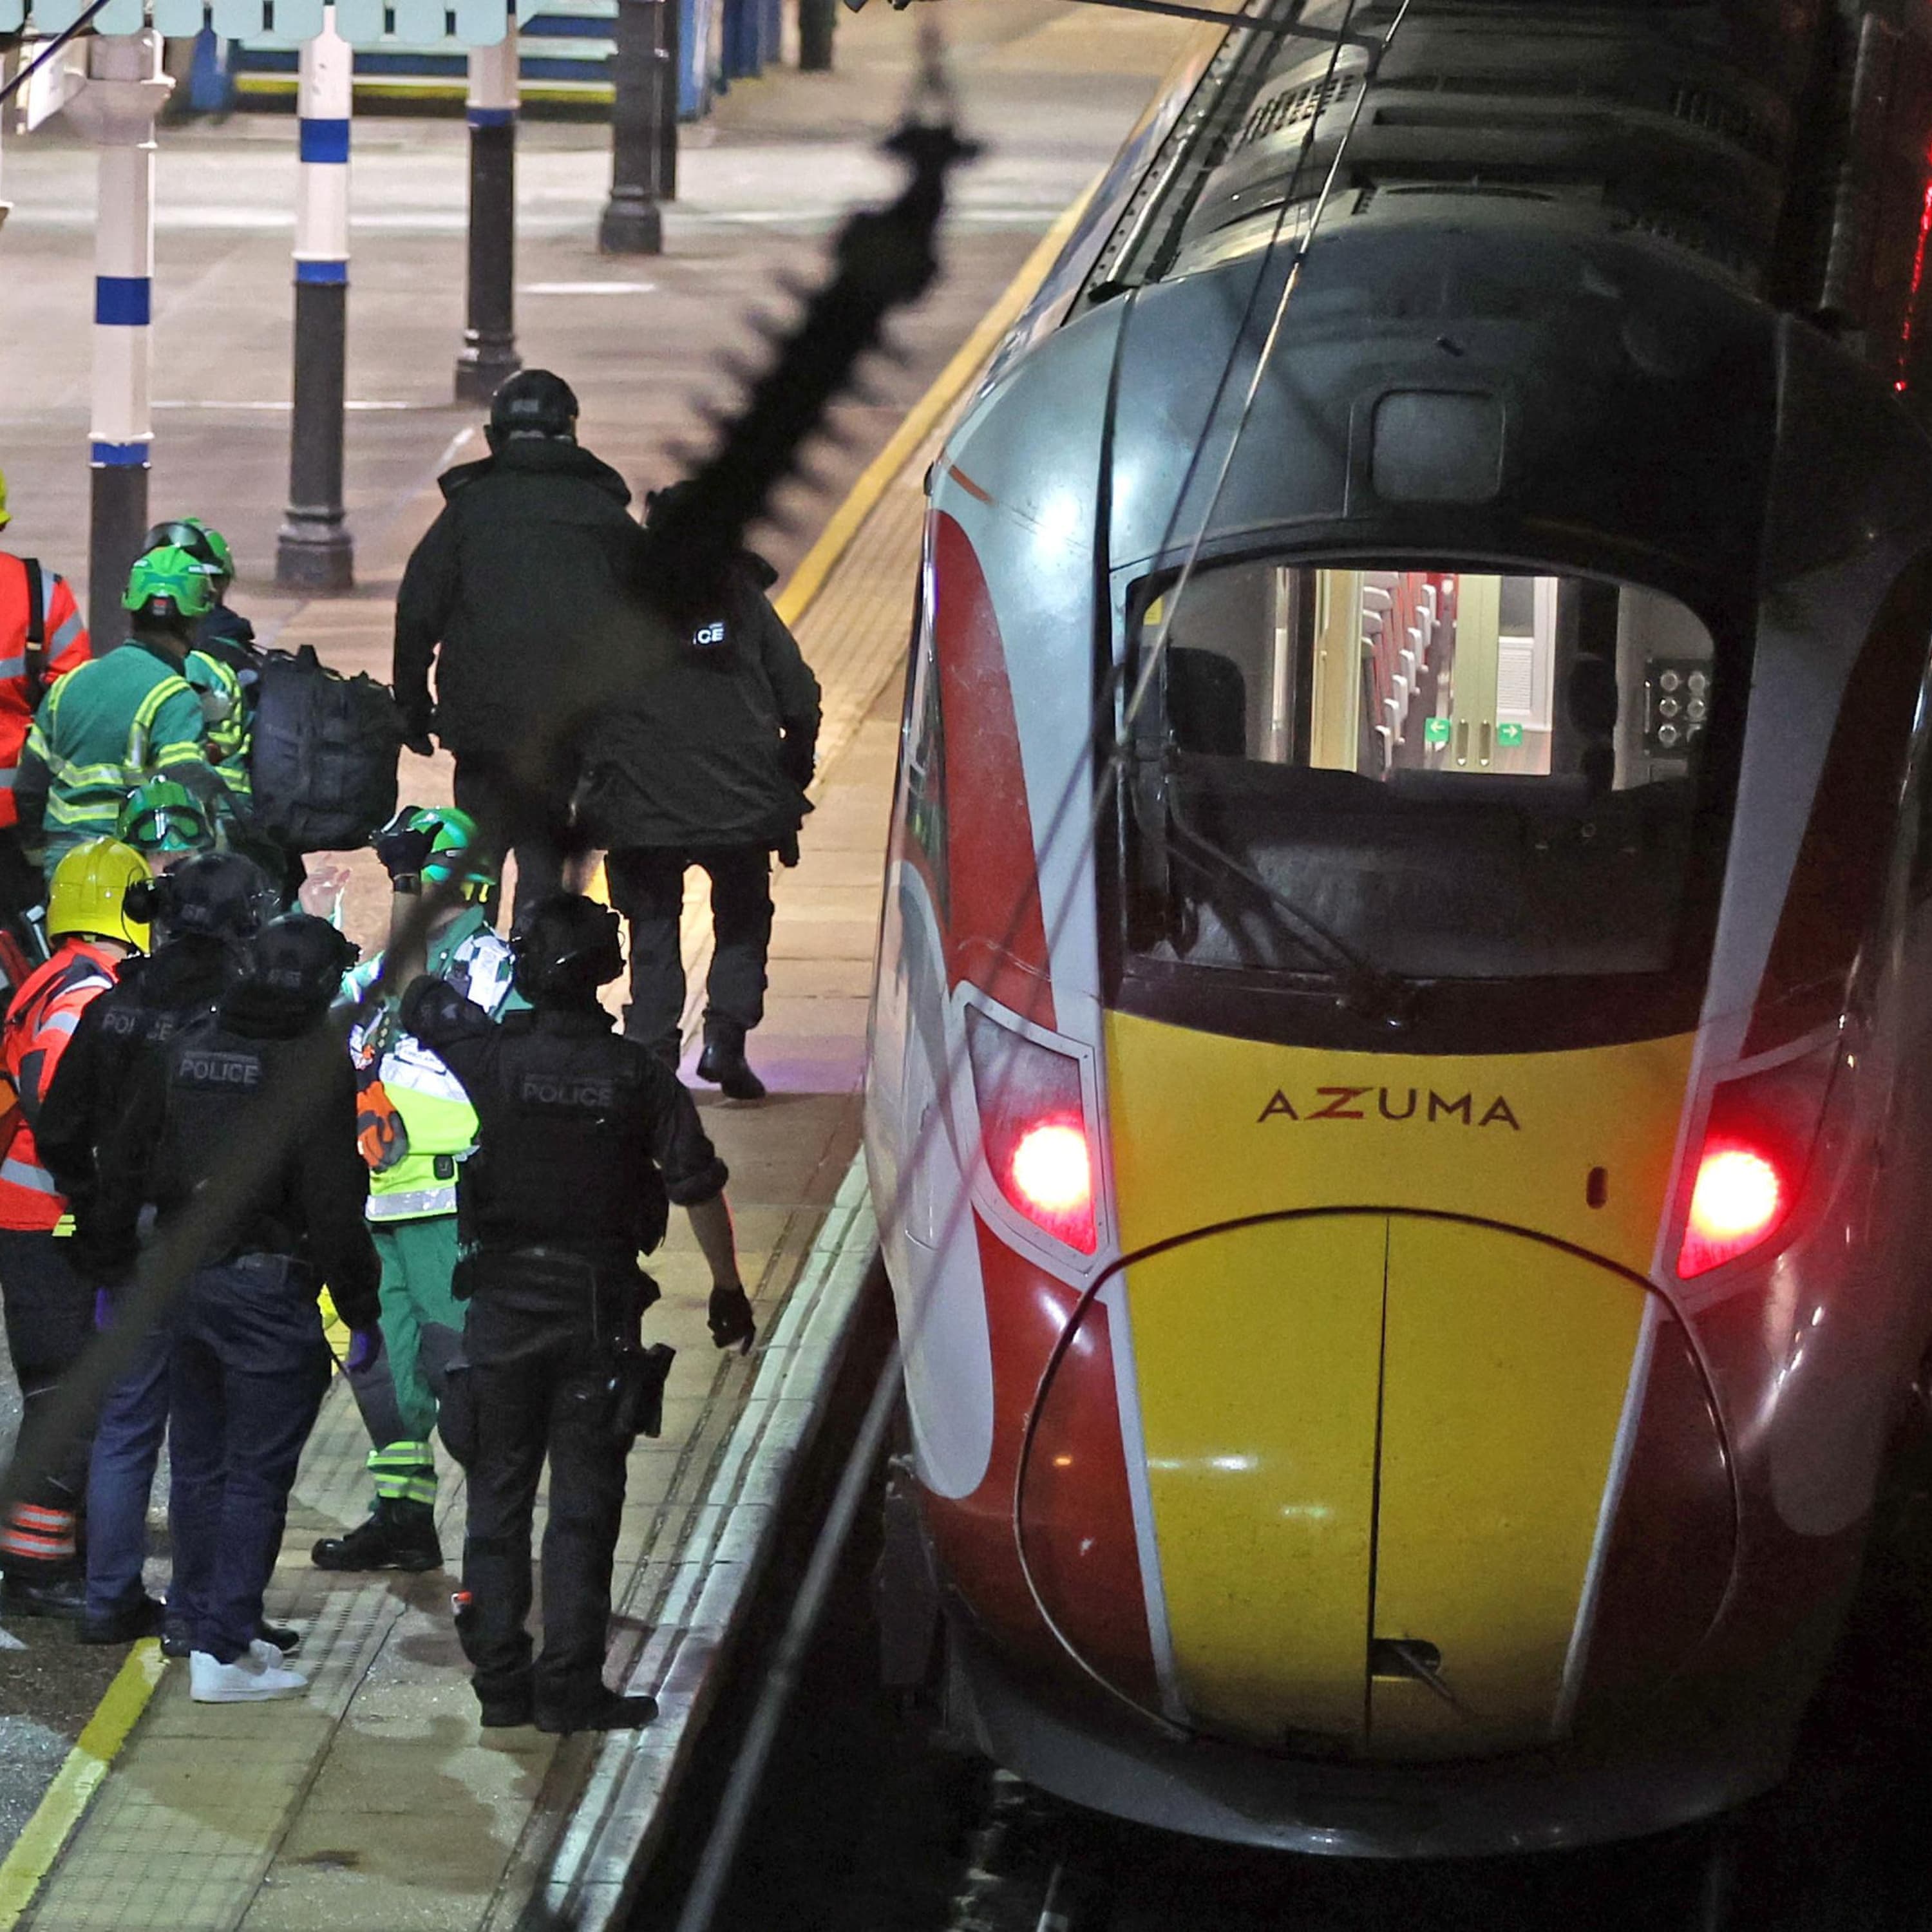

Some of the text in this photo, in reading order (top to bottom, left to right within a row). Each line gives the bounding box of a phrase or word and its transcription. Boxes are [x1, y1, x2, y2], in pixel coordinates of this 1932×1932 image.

[178, 1058, 259, 1084] POLICE
[519, 1082, 613, 1107] POLICE
[1256, 1086, 1521, 1131] AZUMA
